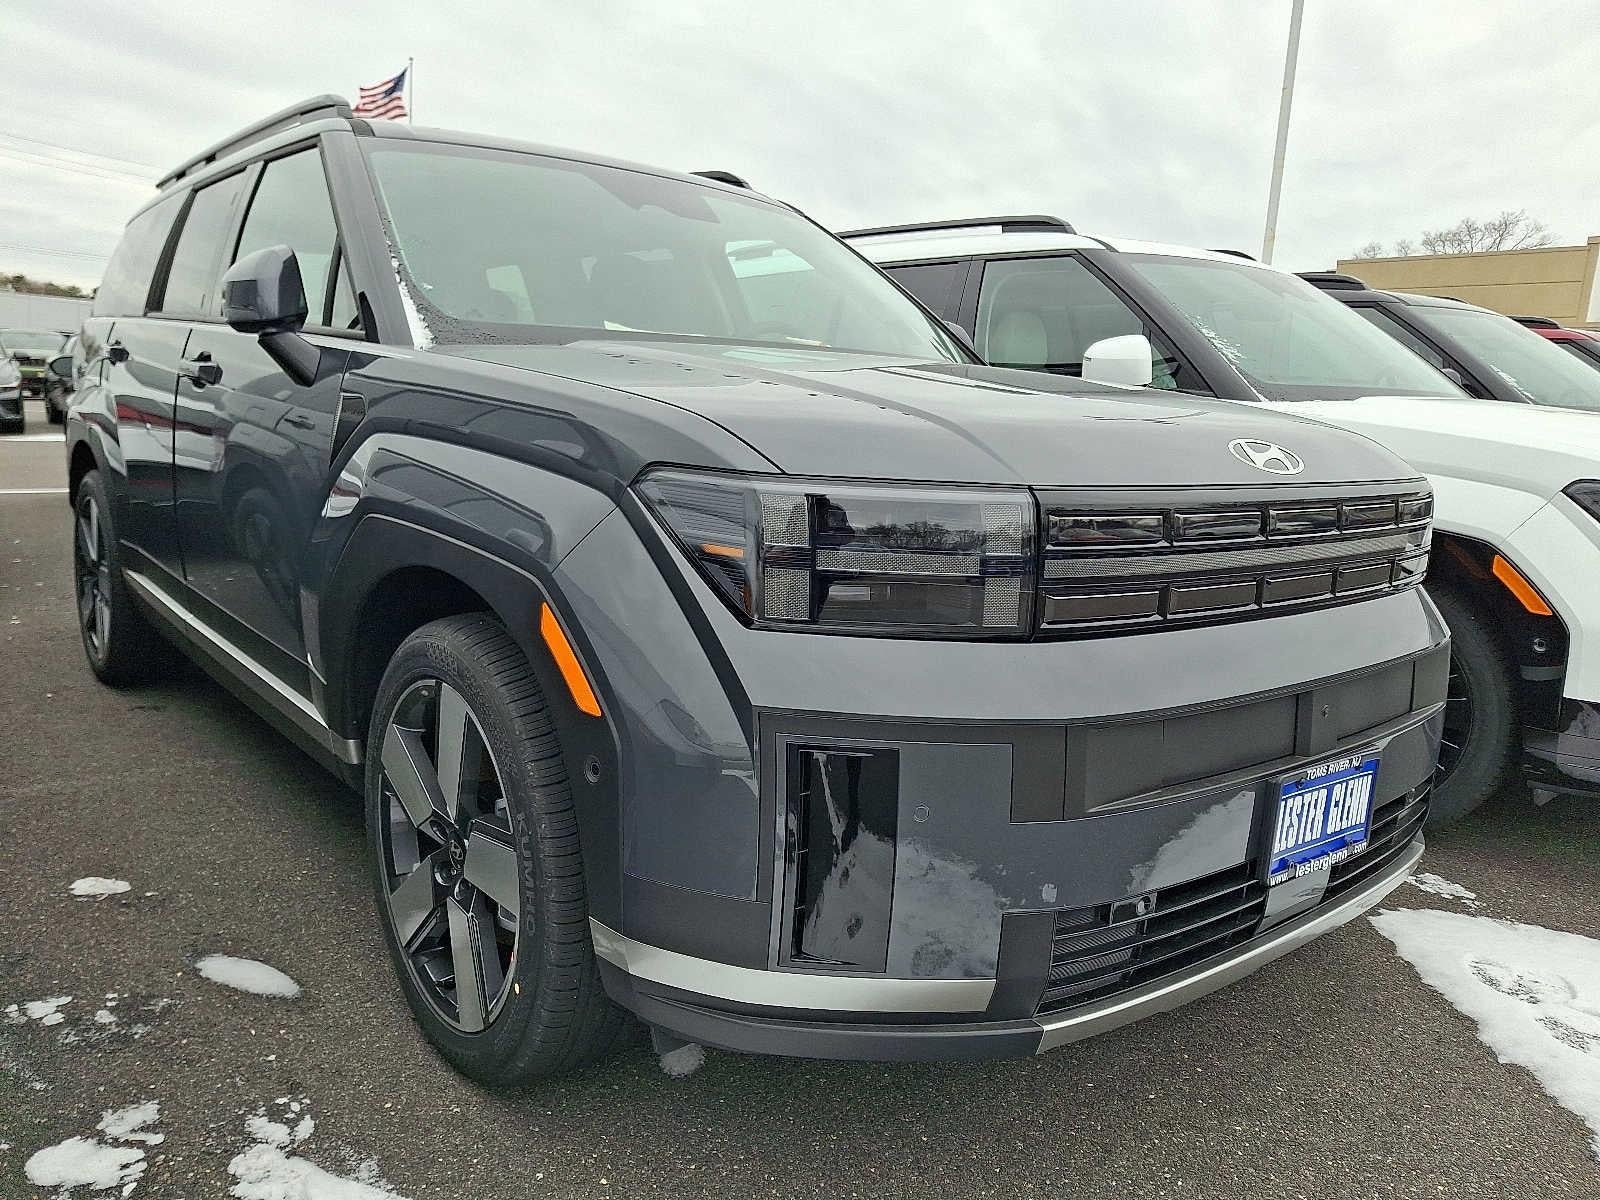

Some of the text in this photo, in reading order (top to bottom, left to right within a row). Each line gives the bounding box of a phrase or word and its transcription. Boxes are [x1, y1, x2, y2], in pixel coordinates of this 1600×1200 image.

[1306, 766, 1328, 780] TOMS
[1350, 756, 1362, 768] NJ
[1273, 775, 1372, 854] LESTER GLENN
